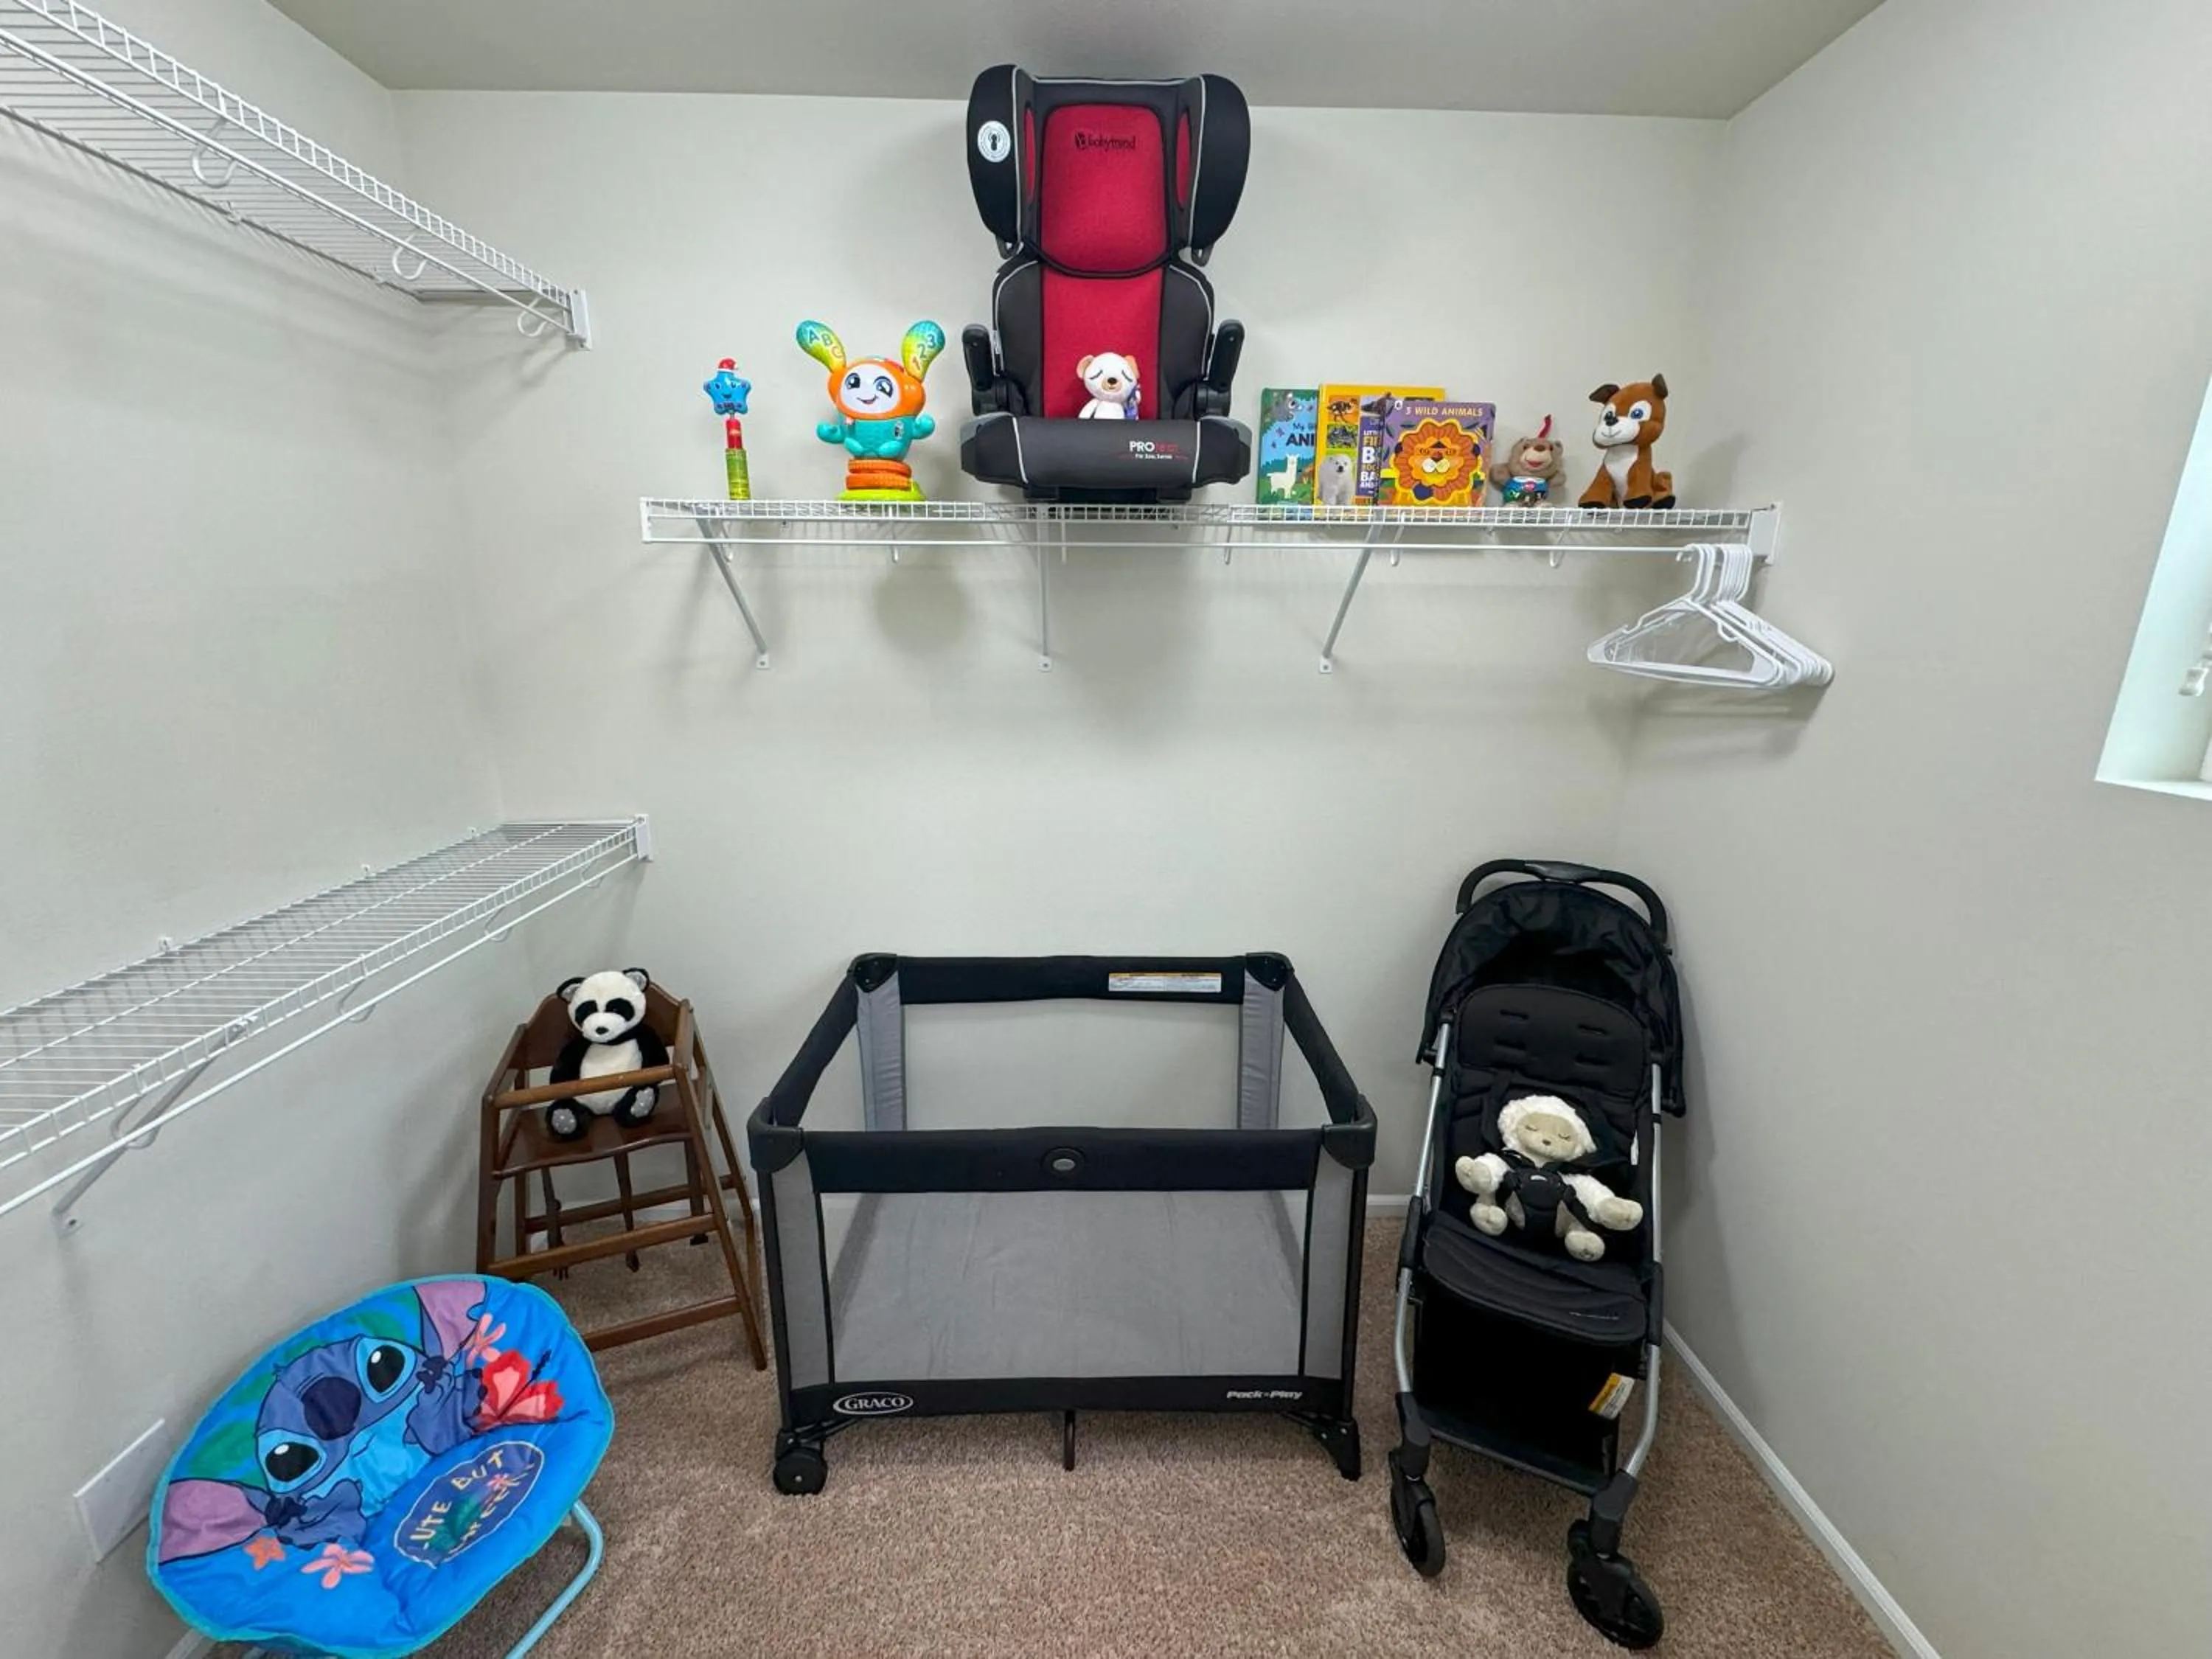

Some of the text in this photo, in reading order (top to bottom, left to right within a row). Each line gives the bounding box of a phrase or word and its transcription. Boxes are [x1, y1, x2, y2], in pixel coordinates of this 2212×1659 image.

[1415, 406, 1439, 416] WILD
[1441, 407, 1484, 417] ANIMALS
[844, 1397, 905, 1410] GRACO
[409, 1500, 452, 1550] UTE
[451, 1449, 504, 1491] BUT
